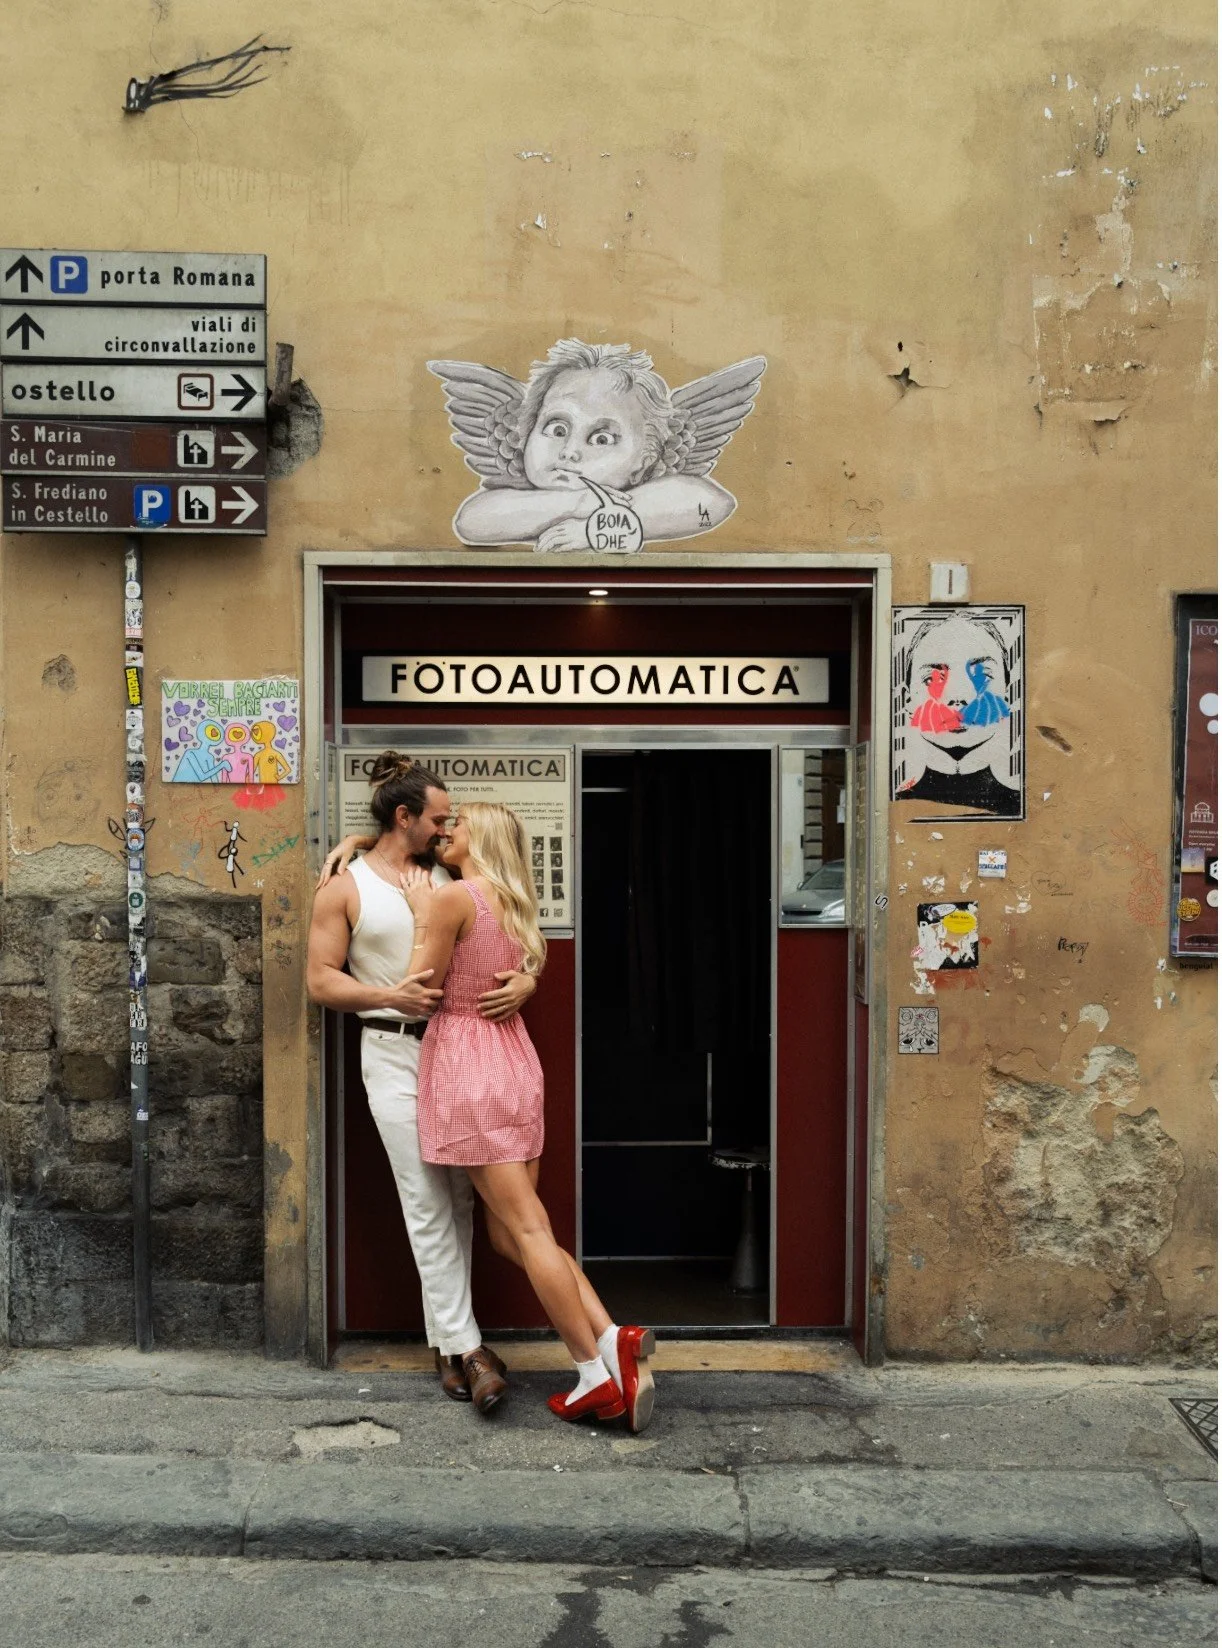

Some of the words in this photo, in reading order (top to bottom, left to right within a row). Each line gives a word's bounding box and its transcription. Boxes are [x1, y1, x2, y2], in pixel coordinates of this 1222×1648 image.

[101, 267, 160, 289] porta
[173, 266, 256, 287] Romana
[191, 316, 232, 333] viali
[241, 316, 256, 333] di
[104, 337, 256, 353] circonvallazione
[11, 380, 115, 402] ostello
[11, 426, 26, 443] S.
[34, 426, 82, 443] Maria
[9, 449, 37, 466] del
[45, 449, 116, 467] Carmine
[12, 483, 27, 500] S.
[34, 483, 108, 500] Frediano
[11, 505, 26, 522] in
[34, 505, 109, 523] Cestello
[206, 698, 262, 717] SEMPRE
